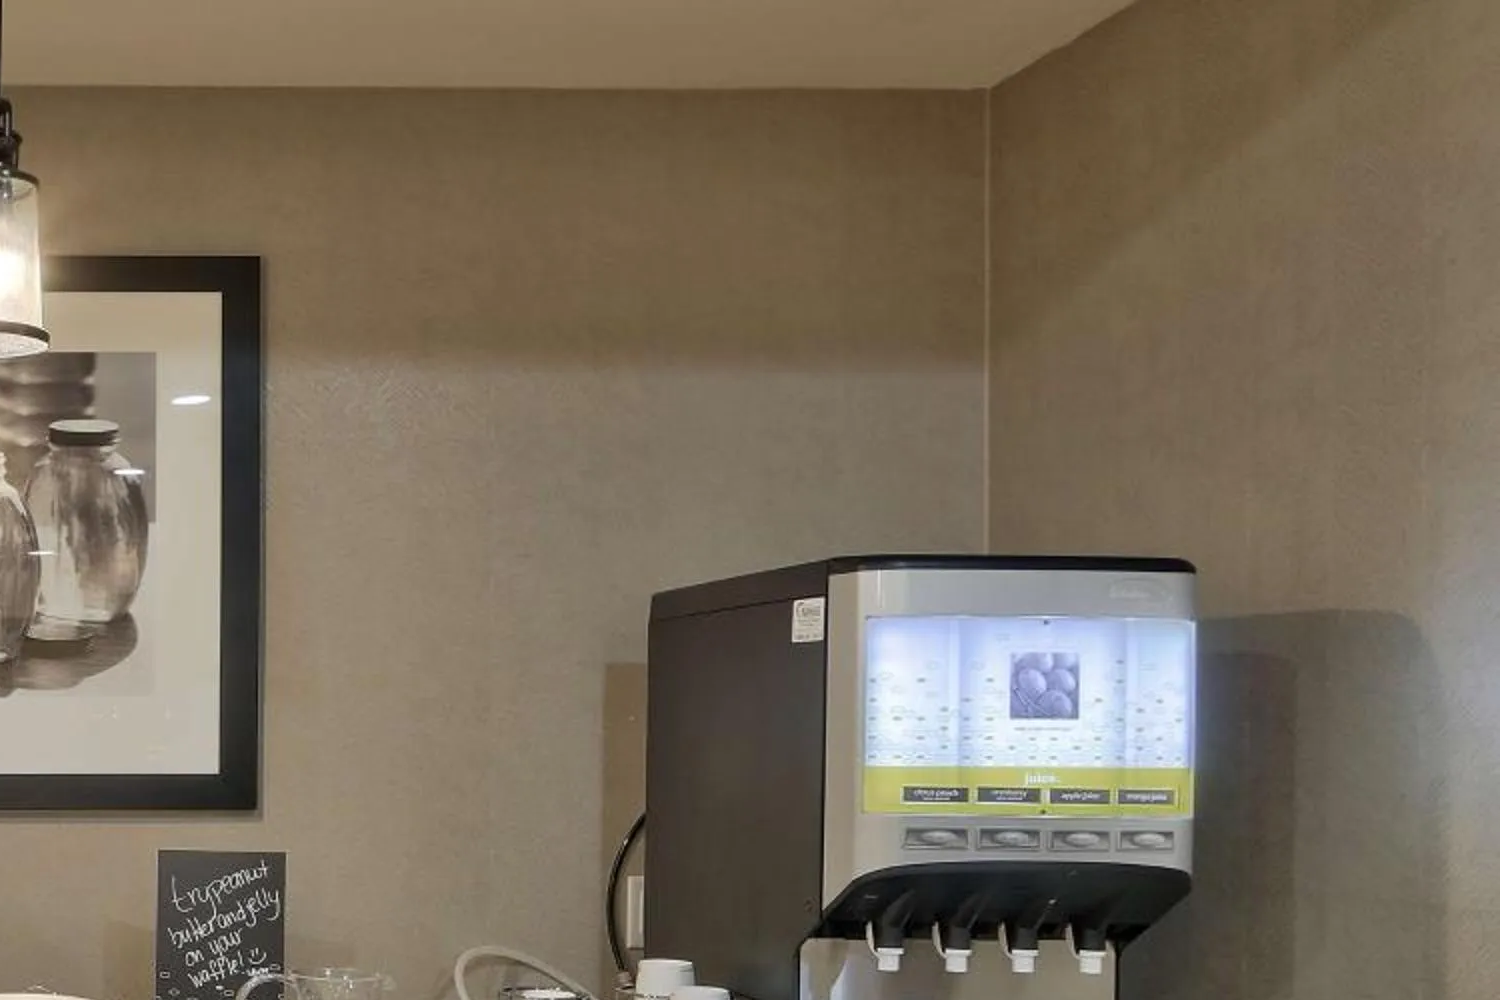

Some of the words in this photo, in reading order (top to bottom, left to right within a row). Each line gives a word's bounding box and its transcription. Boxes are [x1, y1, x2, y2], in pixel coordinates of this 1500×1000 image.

[167, 916, 216, 949] butter
[216, 900, 247, 929] and
[245, 887, 281, 928] jelly
[171, 874, 217, 919] try
[211, 859, 269, 905] peanut
[185, 949, 205, 966] on
[208, 928, 243, 956] your
